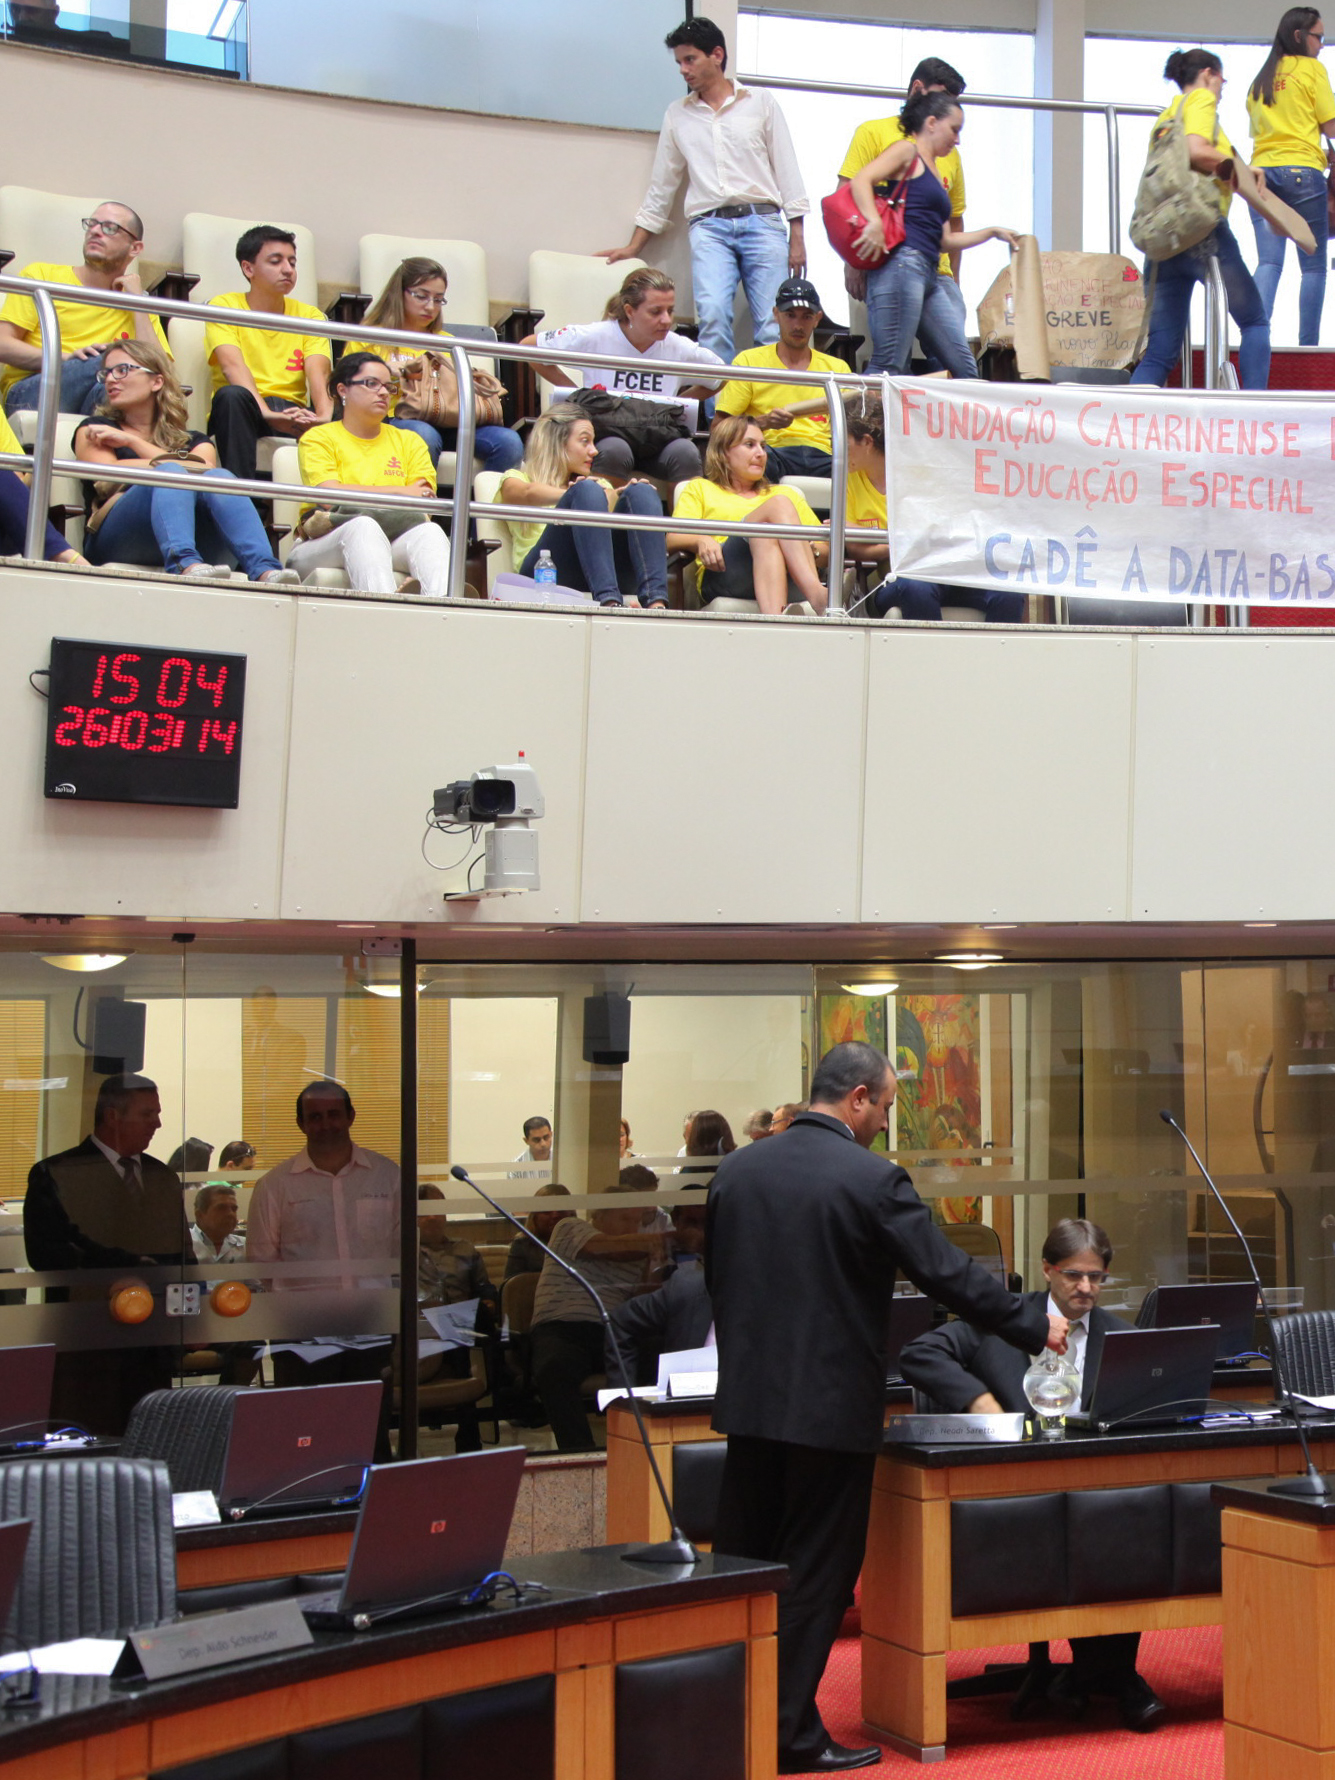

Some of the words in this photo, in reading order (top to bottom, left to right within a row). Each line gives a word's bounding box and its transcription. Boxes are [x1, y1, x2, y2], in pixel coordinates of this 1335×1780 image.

[1046, 310, 1112, 328] GREVE
[613, 370, 663, 392] FCEE
[900, 389, 1056, 450] FUNDAÇÃO
[1077, 401, 1301, 458] CATARINENSE
[974, 448, 1138, 511] EDUCAÇÃO
[1161, 462, 1314, 514] ESPECIAL
[984, 524, 1098, 588] CADÊ
[1121, 543, 1149, 593] A
[92, 653, 141, 704] 15
[156, 657, 228, 708] 04
